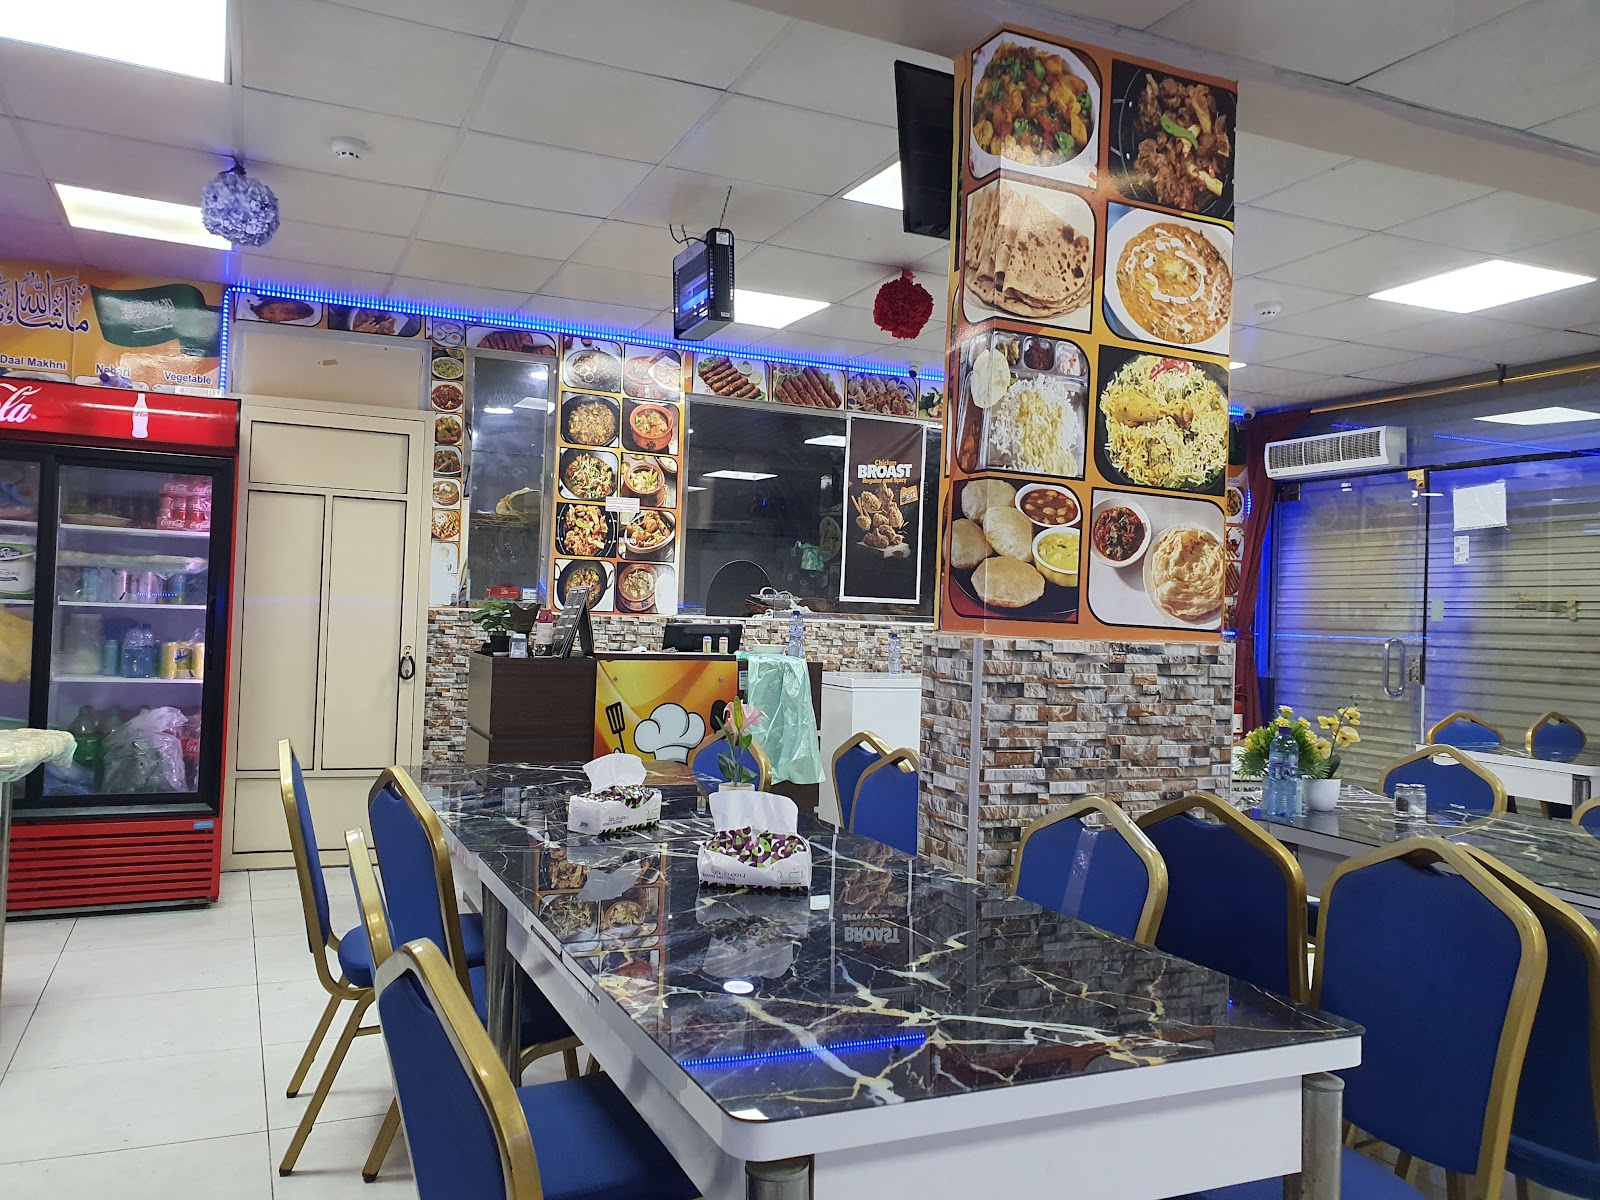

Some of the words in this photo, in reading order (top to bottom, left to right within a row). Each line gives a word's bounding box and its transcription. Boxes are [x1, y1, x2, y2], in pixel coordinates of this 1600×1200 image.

[0, 354, 24, 366] Daal
[27, 357, 67, 370] Makhni
[165, 371, 212, 386] Vegetable
[857, 464, 912, 478] BROAST
